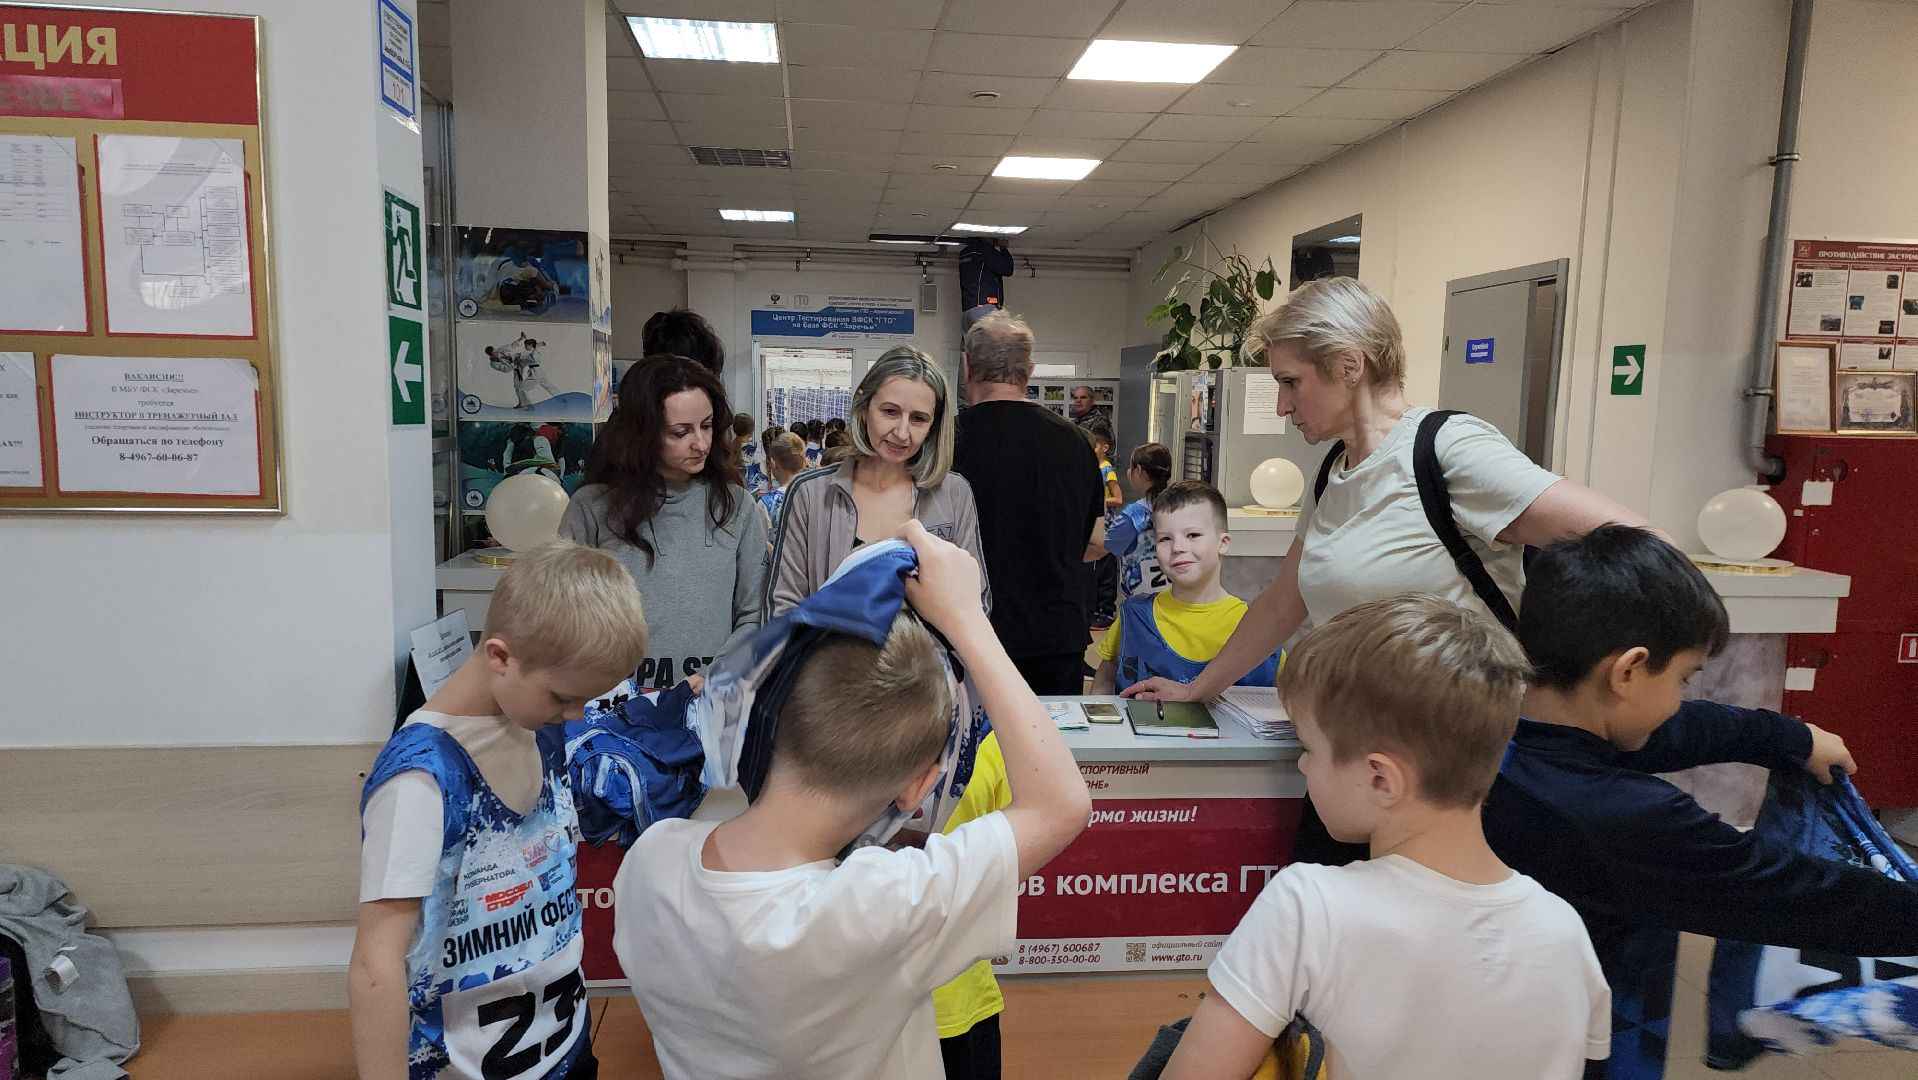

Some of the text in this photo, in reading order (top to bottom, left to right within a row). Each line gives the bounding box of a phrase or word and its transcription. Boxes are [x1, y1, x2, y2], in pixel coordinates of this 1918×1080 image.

[0, 23, 118, 70] ЦИЯ
[772, 314, 796, 322] Центр
[797, 315, 850, 324] Тестирования
[74, 411, 137, 420] ИНСТРУКТОР
[92, 435, 224, 447] Обращаться по телефону
[119, 452, 199, 462] 8-4967-60-06-87
[636, 657, 675, 688] PA
[1080, 763, 1150, 774] СПОРТИВНЫЙ
[1087, 805, 1198, 828] рма жизни!
[463, 863, 499, 881] КОМАНДА
[464, 868, 516, 891] ГУБЕРНАТОРА
[1056, 872, 1228, 896] комплекса
[1239, 864, 1289, 893] ГТ
[484, 880, 534, 904] МОСОБЛ
[486, 892, 526, 912] СПОРТ
[442, 903, 539, 968] ЗИМНИЙ
[1018, 940, 1223, 955] 8 (4967) 600687 официальный сайт
[1018, 953, 1203, 965] 8-800-350-00-00 www.gto.ru
[477, 966, 586, 1080] 23
